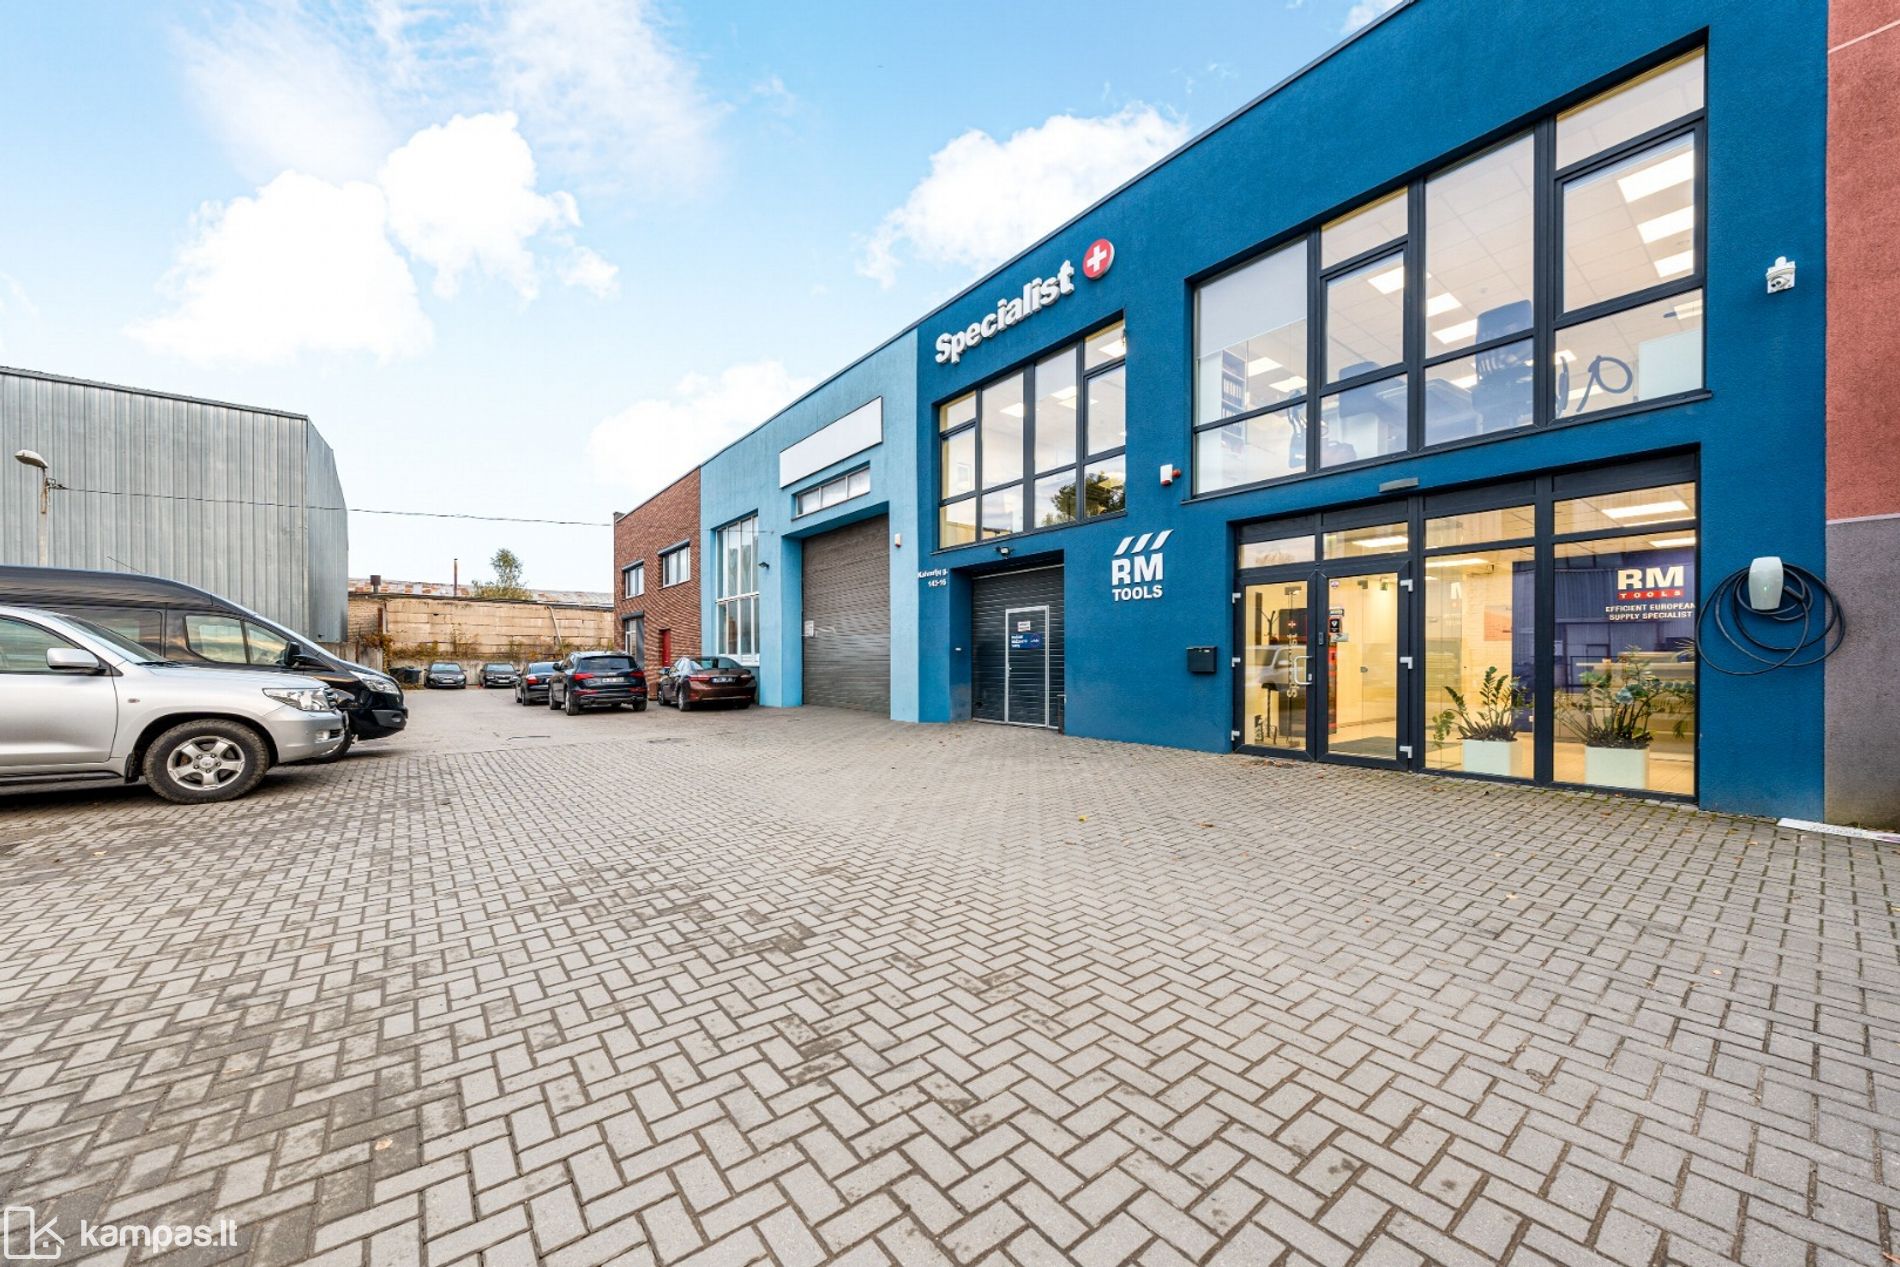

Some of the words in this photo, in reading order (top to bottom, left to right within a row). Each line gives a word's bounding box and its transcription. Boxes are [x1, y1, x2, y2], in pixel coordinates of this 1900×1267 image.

[935, 259, 1075, 364] Specialist
[1112, 552, 1163, 586] RM
[1617, 566, 1685, 590] RM
[1112, 584, 1163, 601] TOOLS
[1620, 590, 1682, 599] TOOLS
[1605, 604, 1647, 613] EFFICIENT
[1609, 613, 1640, 621] SUPPLY
[1642, 611, 1693, 619] SPECIALIST
